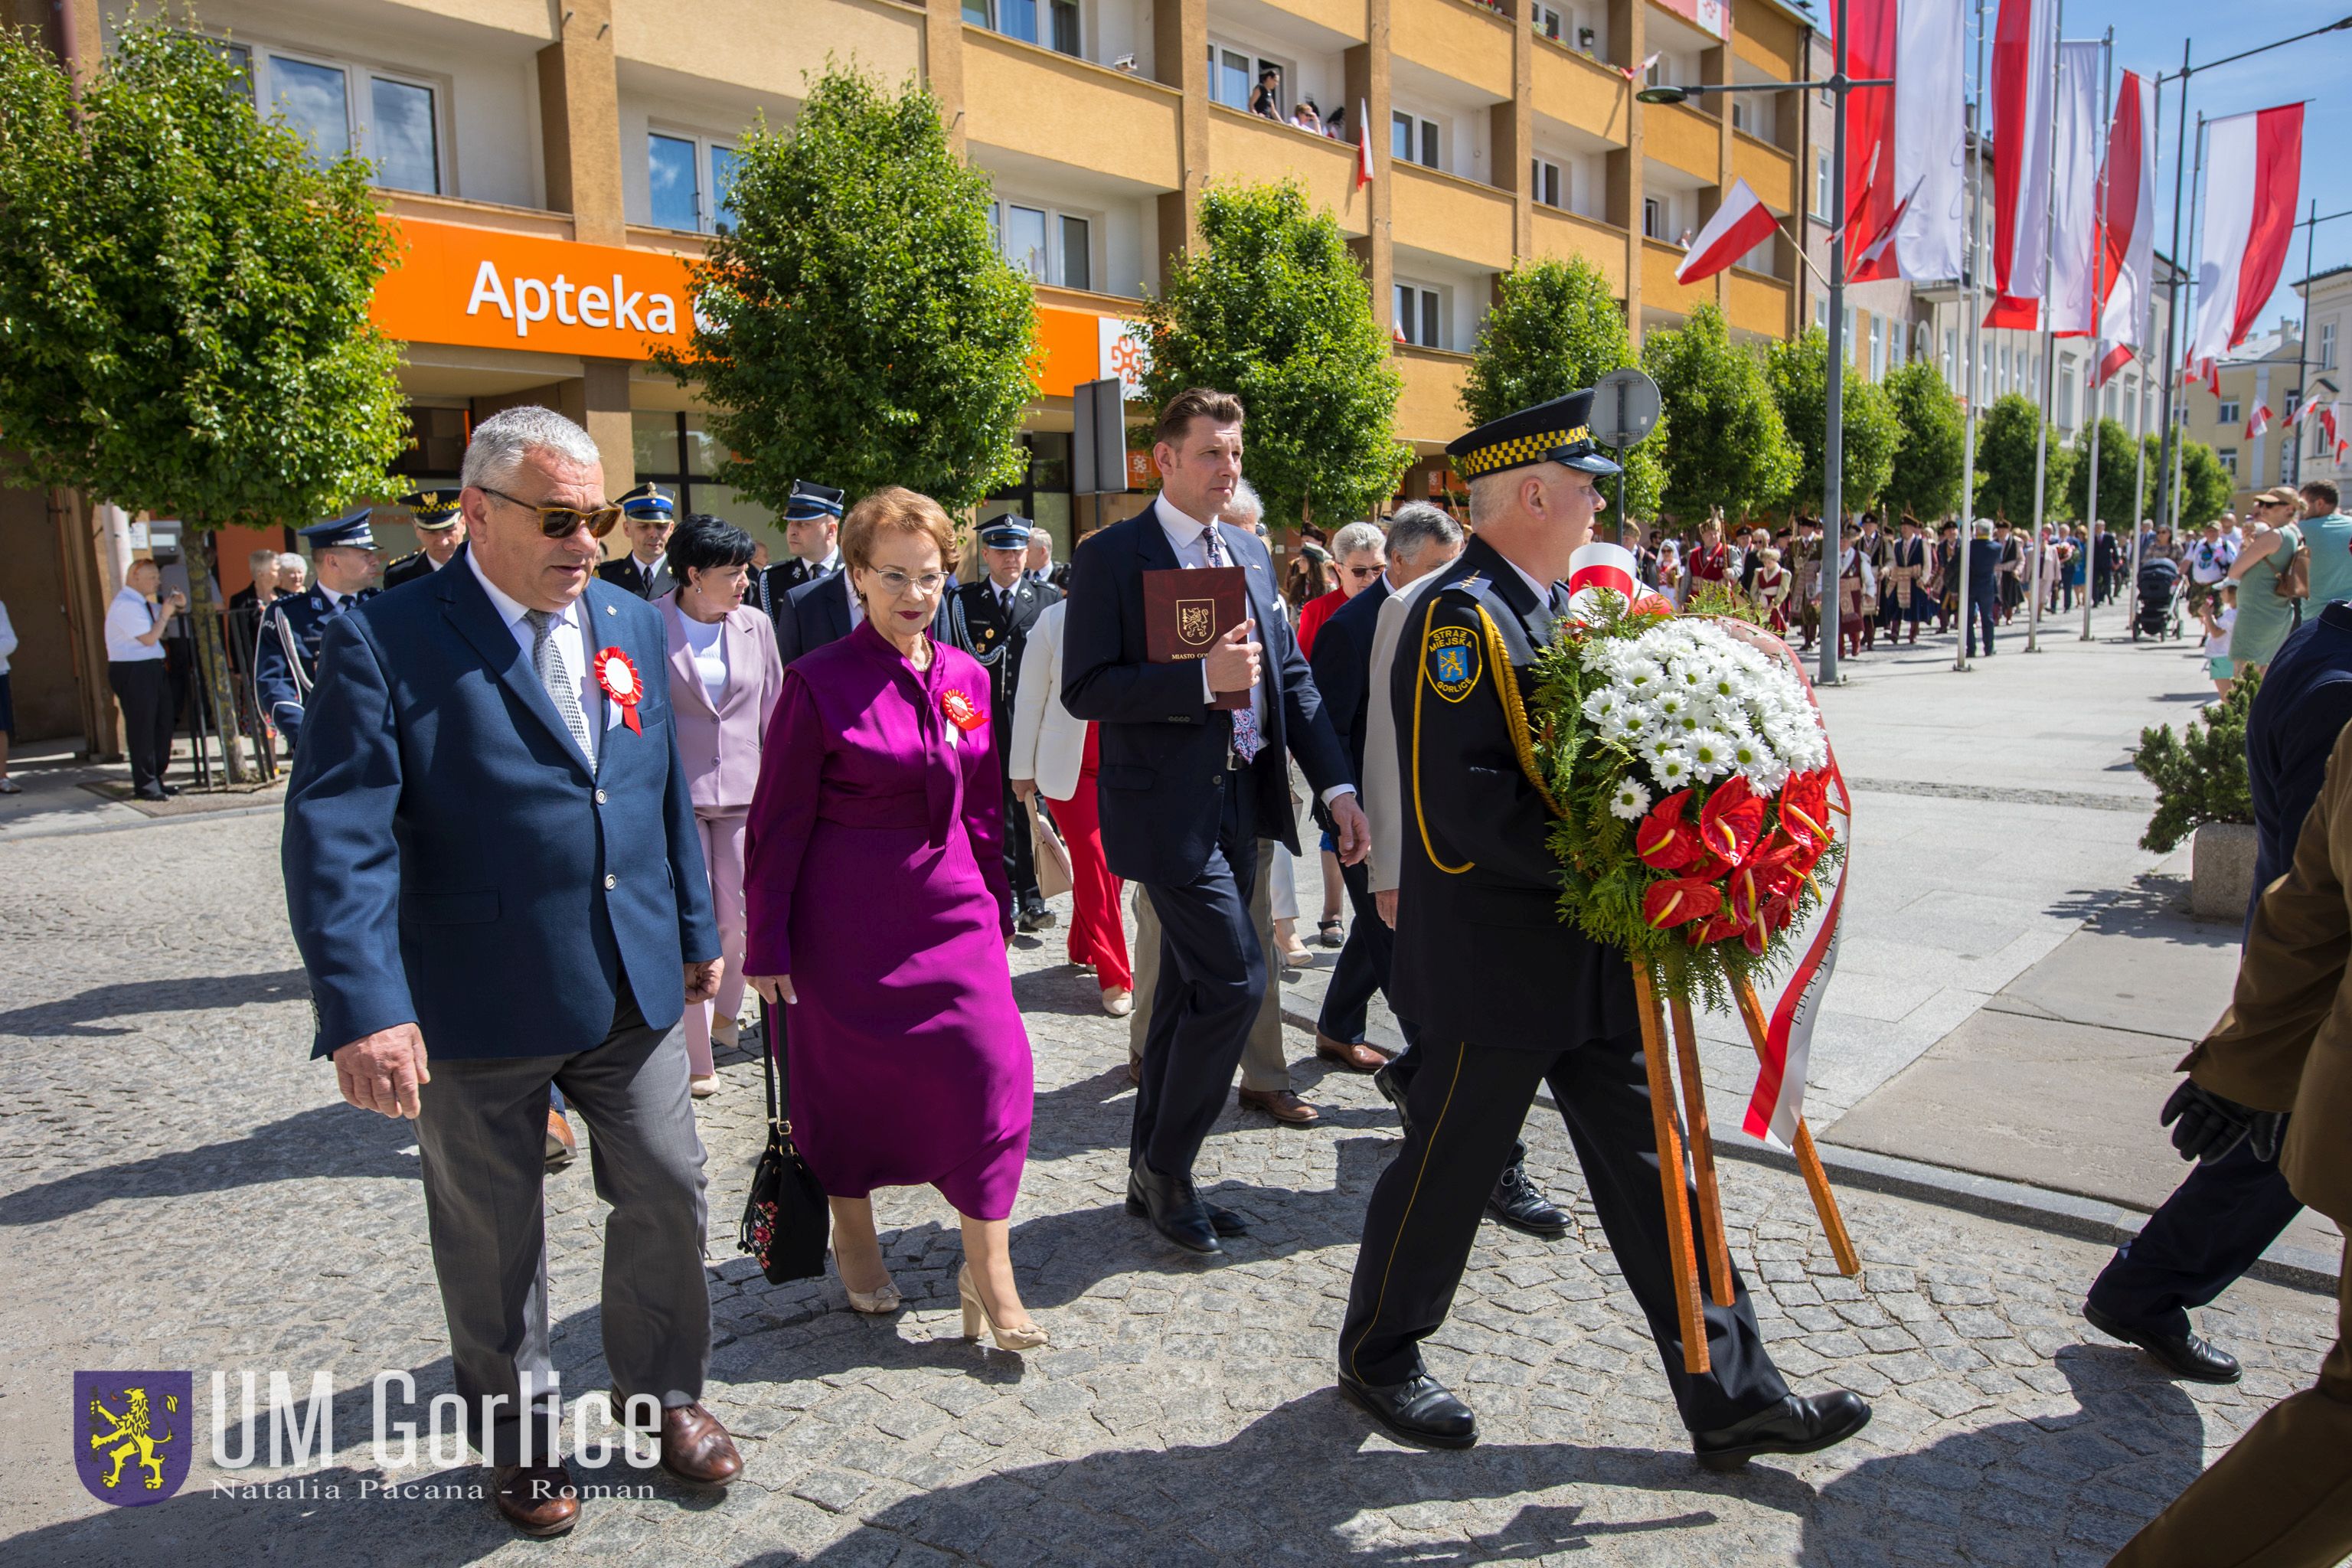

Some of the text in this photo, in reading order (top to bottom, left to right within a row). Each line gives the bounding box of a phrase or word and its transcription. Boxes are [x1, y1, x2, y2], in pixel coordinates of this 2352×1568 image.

[466, 260, 676, 337] Apteka
[1429, 638, 1472, 652] MIEJSKA
[1436, 678, 1472, 693] GORLICE
